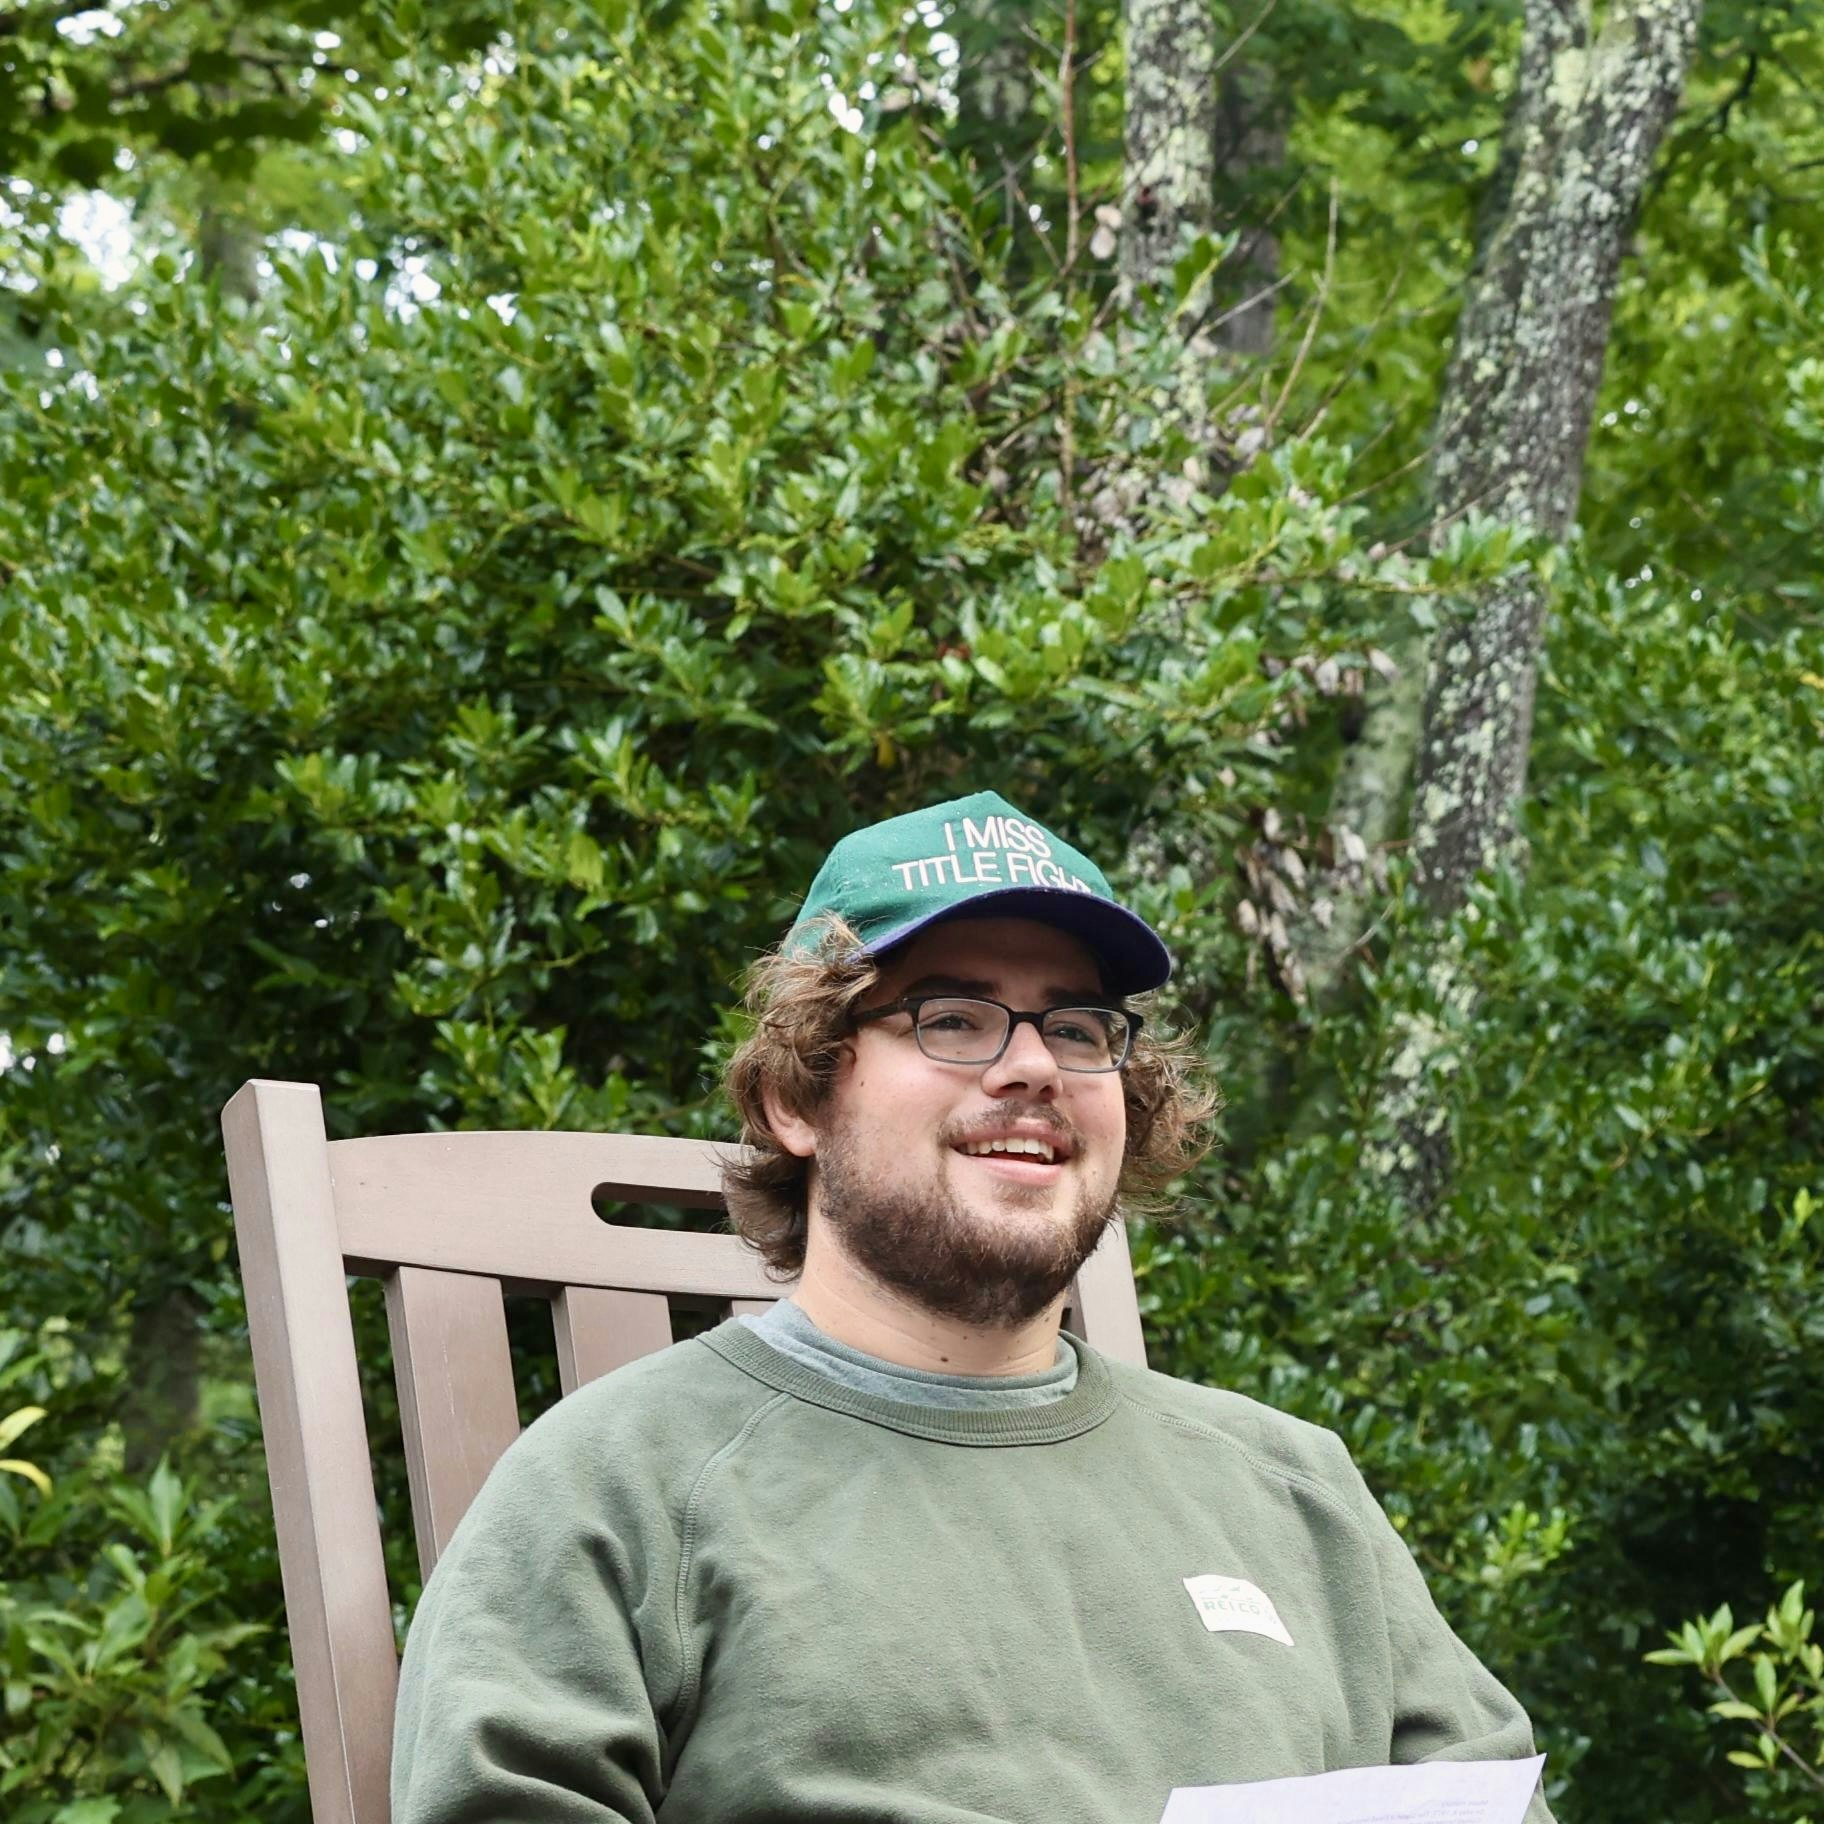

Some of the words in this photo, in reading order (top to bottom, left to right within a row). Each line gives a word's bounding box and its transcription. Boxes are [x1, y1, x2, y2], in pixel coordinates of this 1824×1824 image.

[943, 822, 956, 852] I
[962, 815, 1052, 859] MISS
[891, 851, 1003, 891] TITLE
